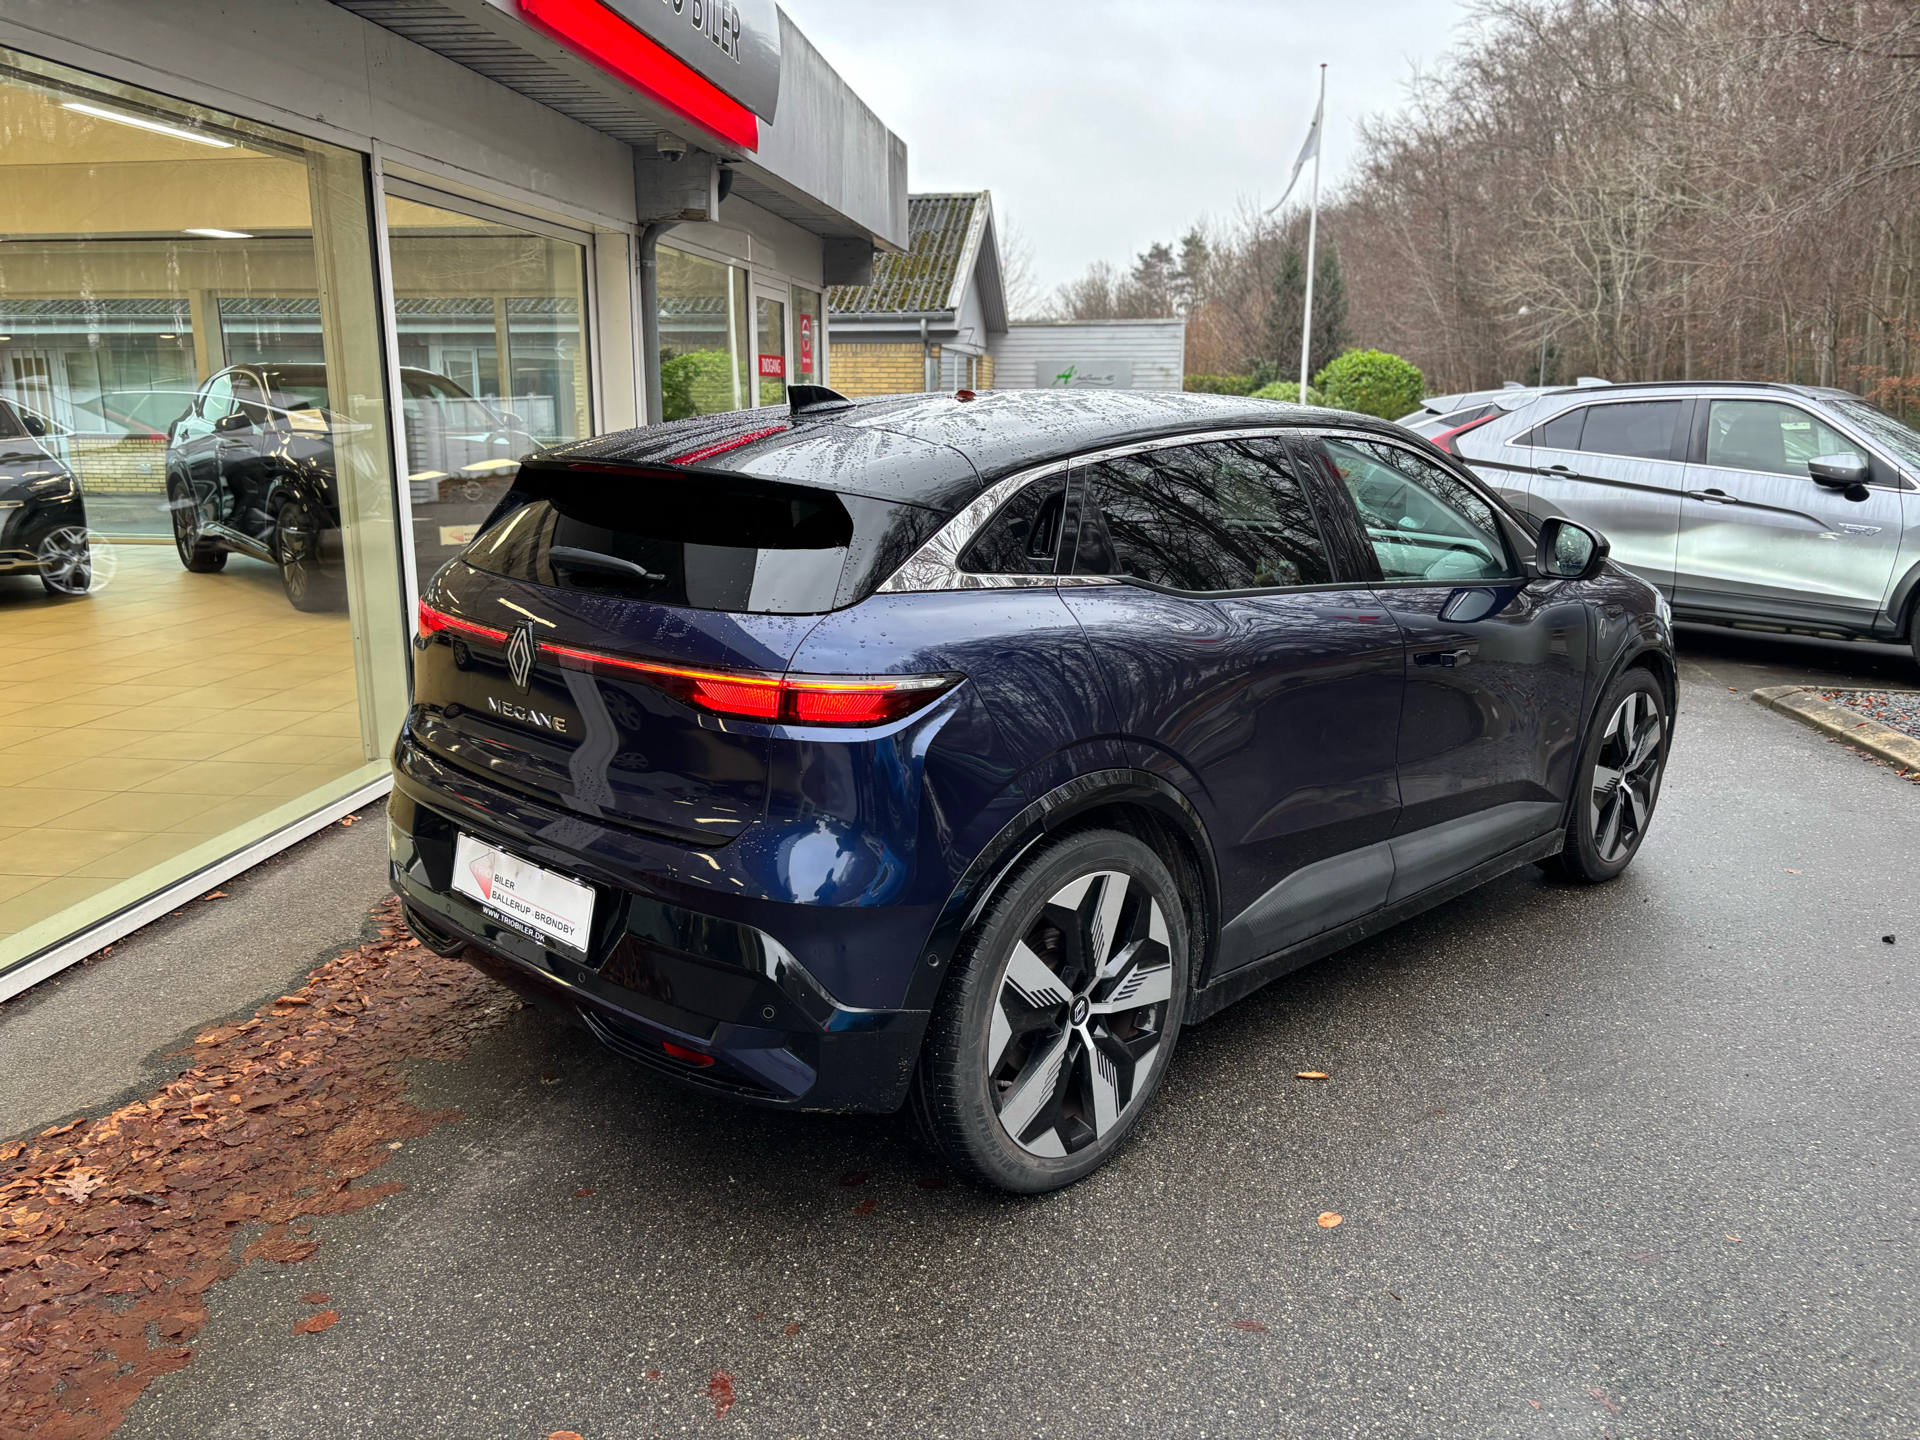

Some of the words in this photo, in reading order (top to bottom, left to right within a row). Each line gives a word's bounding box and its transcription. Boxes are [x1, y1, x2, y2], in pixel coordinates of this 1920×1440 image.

[761, 357, 782, 374] INDGANG
[487, 696, 567, 733] MEGANE
[473, 864, 491, 879] TRIO
[494, 873, 515, 891] BILER
[482, 905, 545, 943] WWW.TRIOBILER.DK
[534, 910, 576, 936] BRØNDBY
